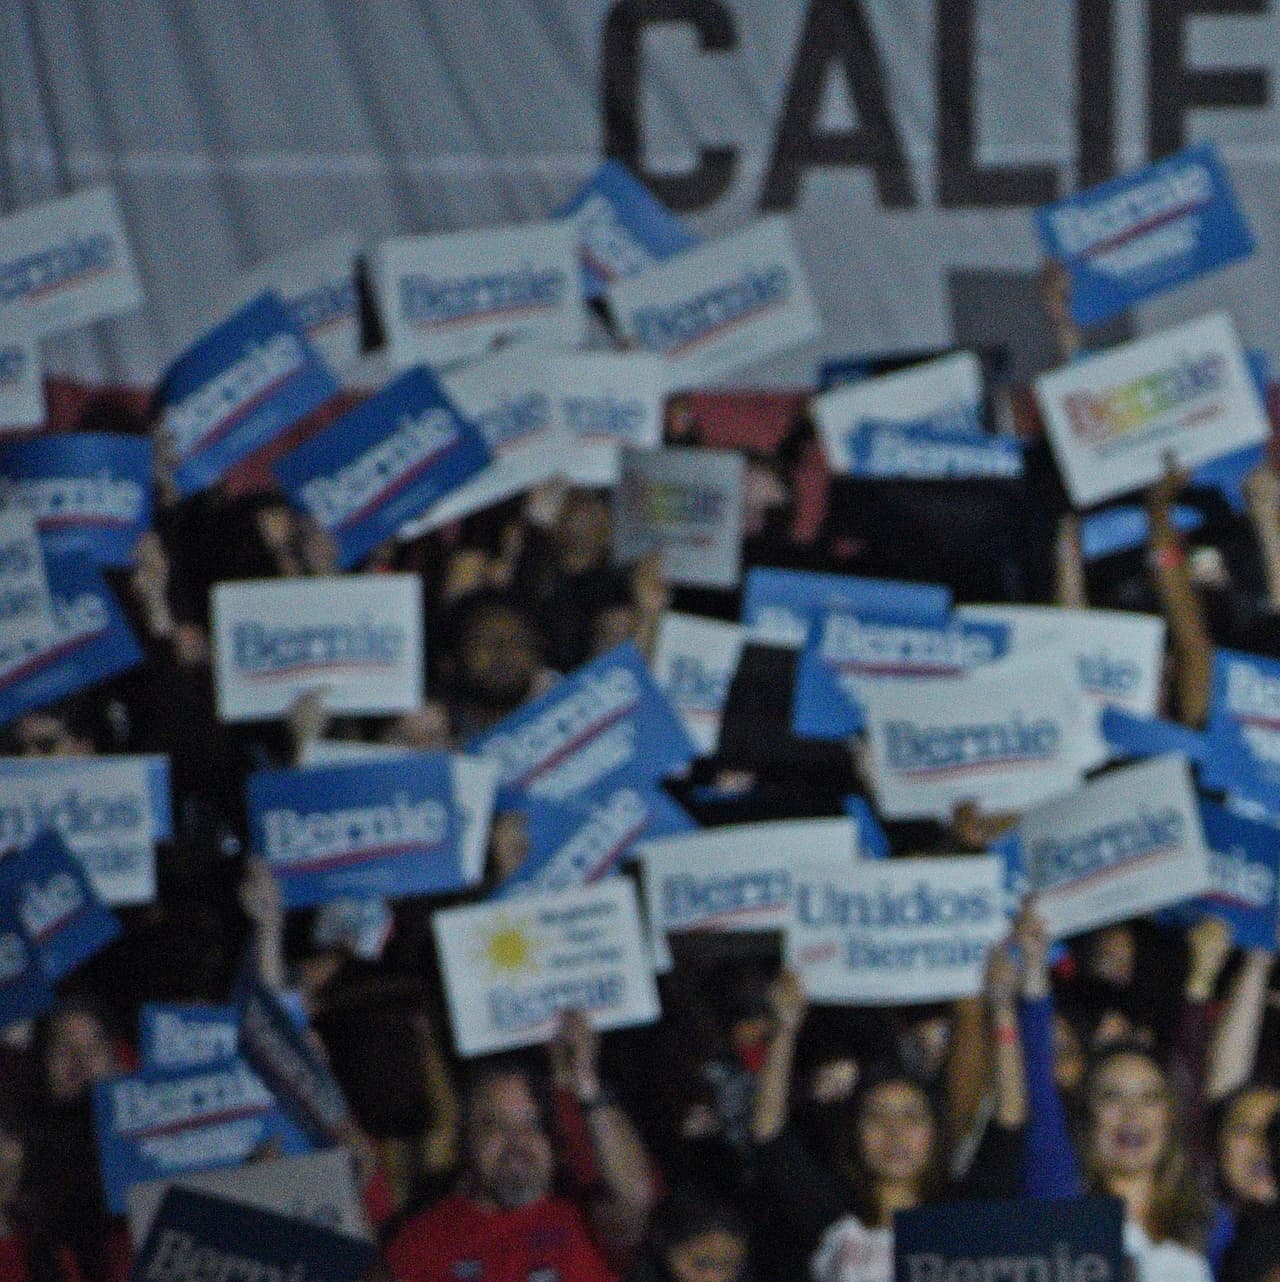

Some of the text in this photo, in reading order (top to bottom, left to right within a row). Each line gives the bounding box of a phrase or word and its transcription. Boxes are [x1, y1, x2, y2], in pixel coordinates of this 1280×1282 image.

[0, 236, 114, 299] ernie
[397, 265, 563, 330] Bernie
[632, 262, 790, 347] Bernie
[230, 618, 405, 682] Bernie
[823, 605, 993, 668] Bernie
[881, 708, 1061, 770] Bernie
[263, 790, 450, 862] Bernie
[1029, 799, 1189, 884] Bernie
[797, 880, 996, 930] Unidos
